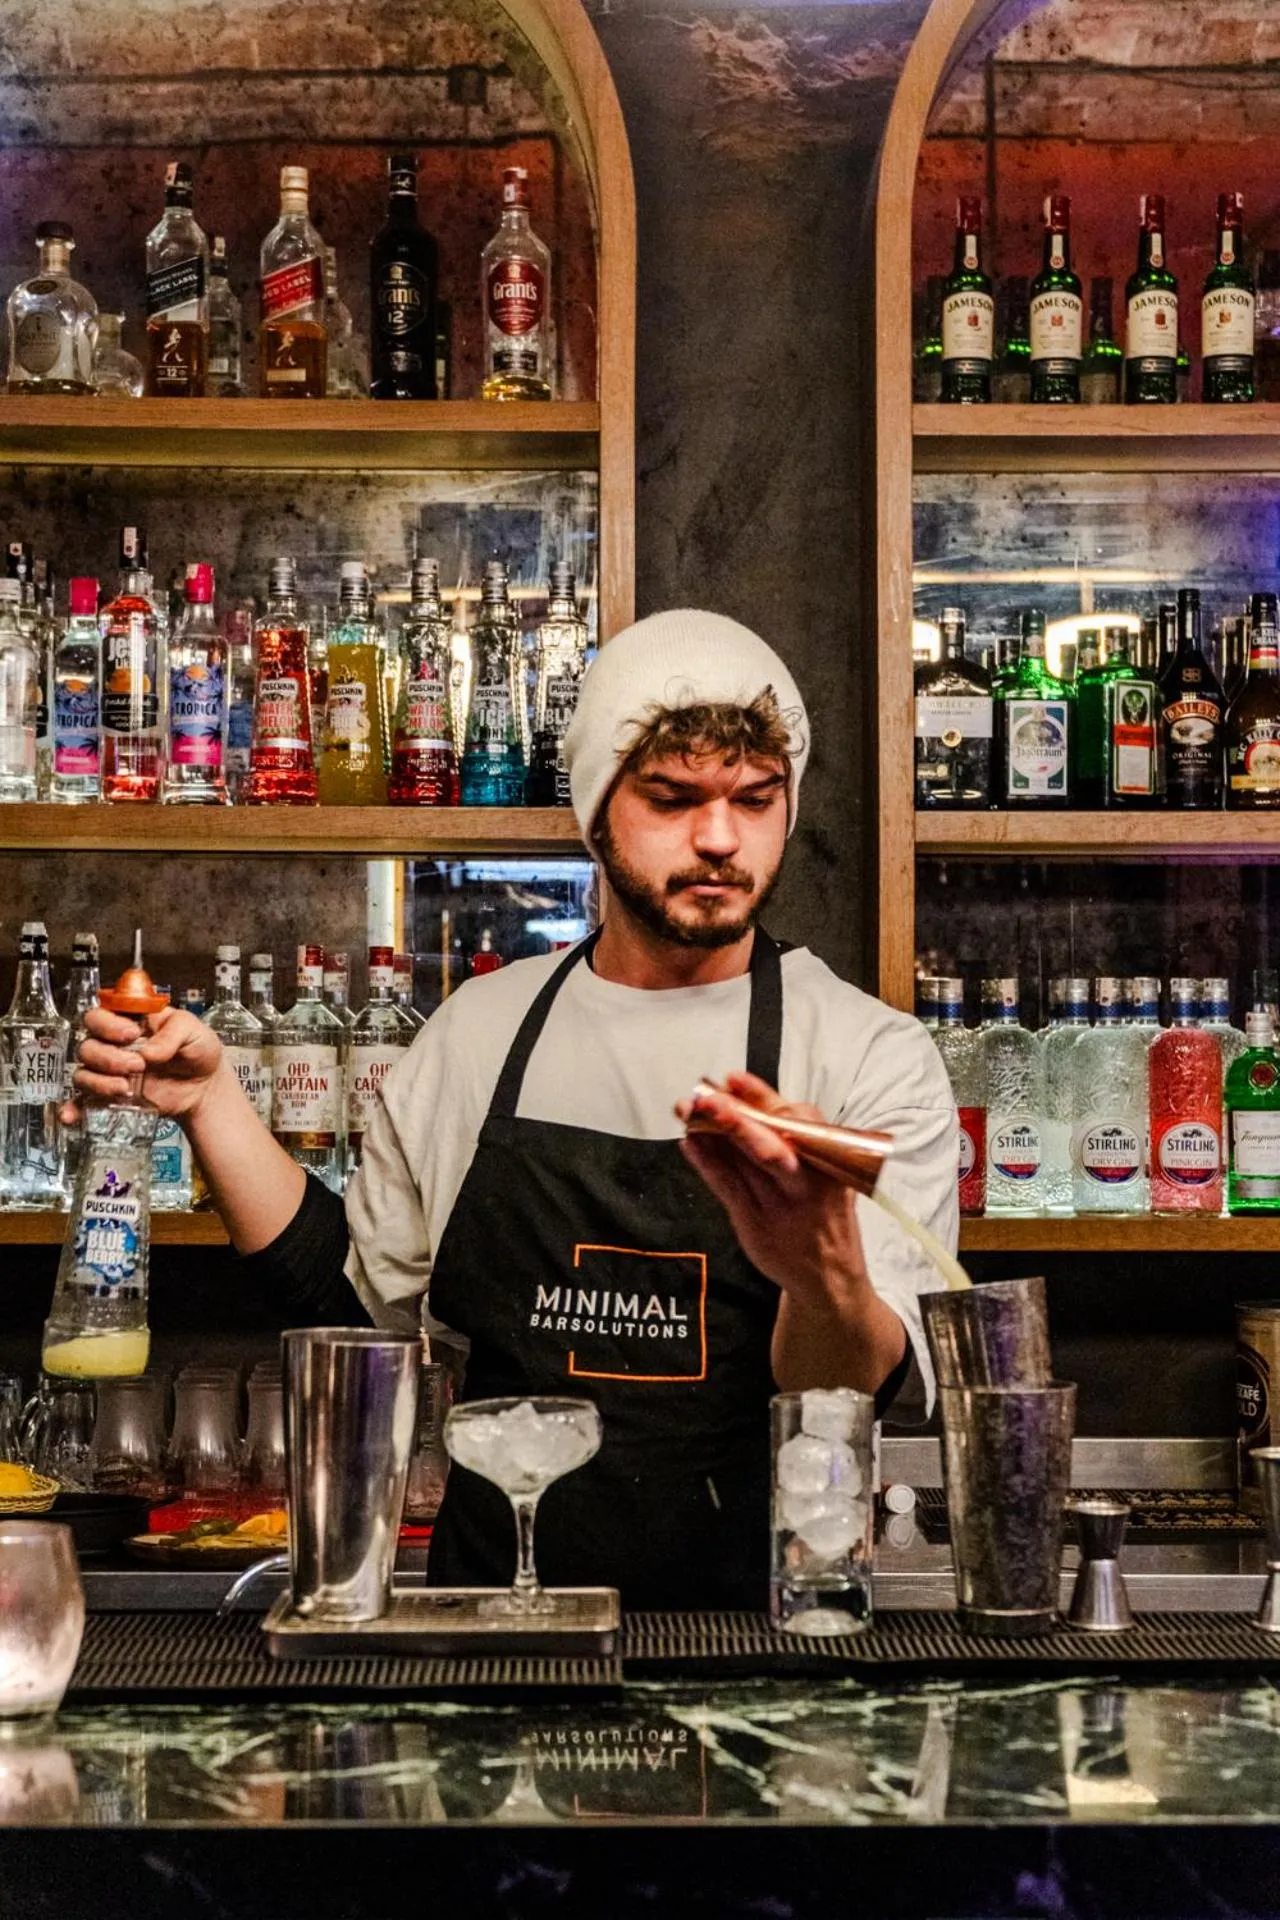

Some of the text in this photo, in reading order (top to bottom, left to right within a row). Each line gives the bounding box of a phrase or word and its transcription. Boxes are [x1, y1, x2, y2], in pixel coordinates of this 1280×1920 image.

[172, 273, 198, 287] LABEL
[281, 275, 311, 292] LABEL
[493, 282, 538, 300] Grant's
[947, 298, 993, 313] JAMESON
[1033, 297, 1080, 314] JAMESON
[1133, 296, 1177, 312] JAMESO
[1203, 294, 1250, 310] JAMESON
[388, 310, 404, 324] 12
[166, 366, 178, 378] 12
[261, 682, 296, 691] PUSCHKIN
[409, 684, 443, 692] PUSCHKIN
[476, 689, 509, 698] PUSCHKIN
[1166, 702, 1217, 718] BAILEYS
[287, 1062, 310, 1077] OLD
[276, 1077, 328, 1091] CAPTAIN
[997, 1135, 1039, 1148] STIRLIN
[1088, 1137, 1136, 1150] STIRLING
[1167, 1138, 1216, 1152] STIRLING
[85, 1200, 136, 1217] PUSCHKIN
[87, 1229, 126, 1250] BLUE
[535, 1284, 688, 1321] MINIMAL
[530, 1313, 688, 1339] BARSOLUTIONS
